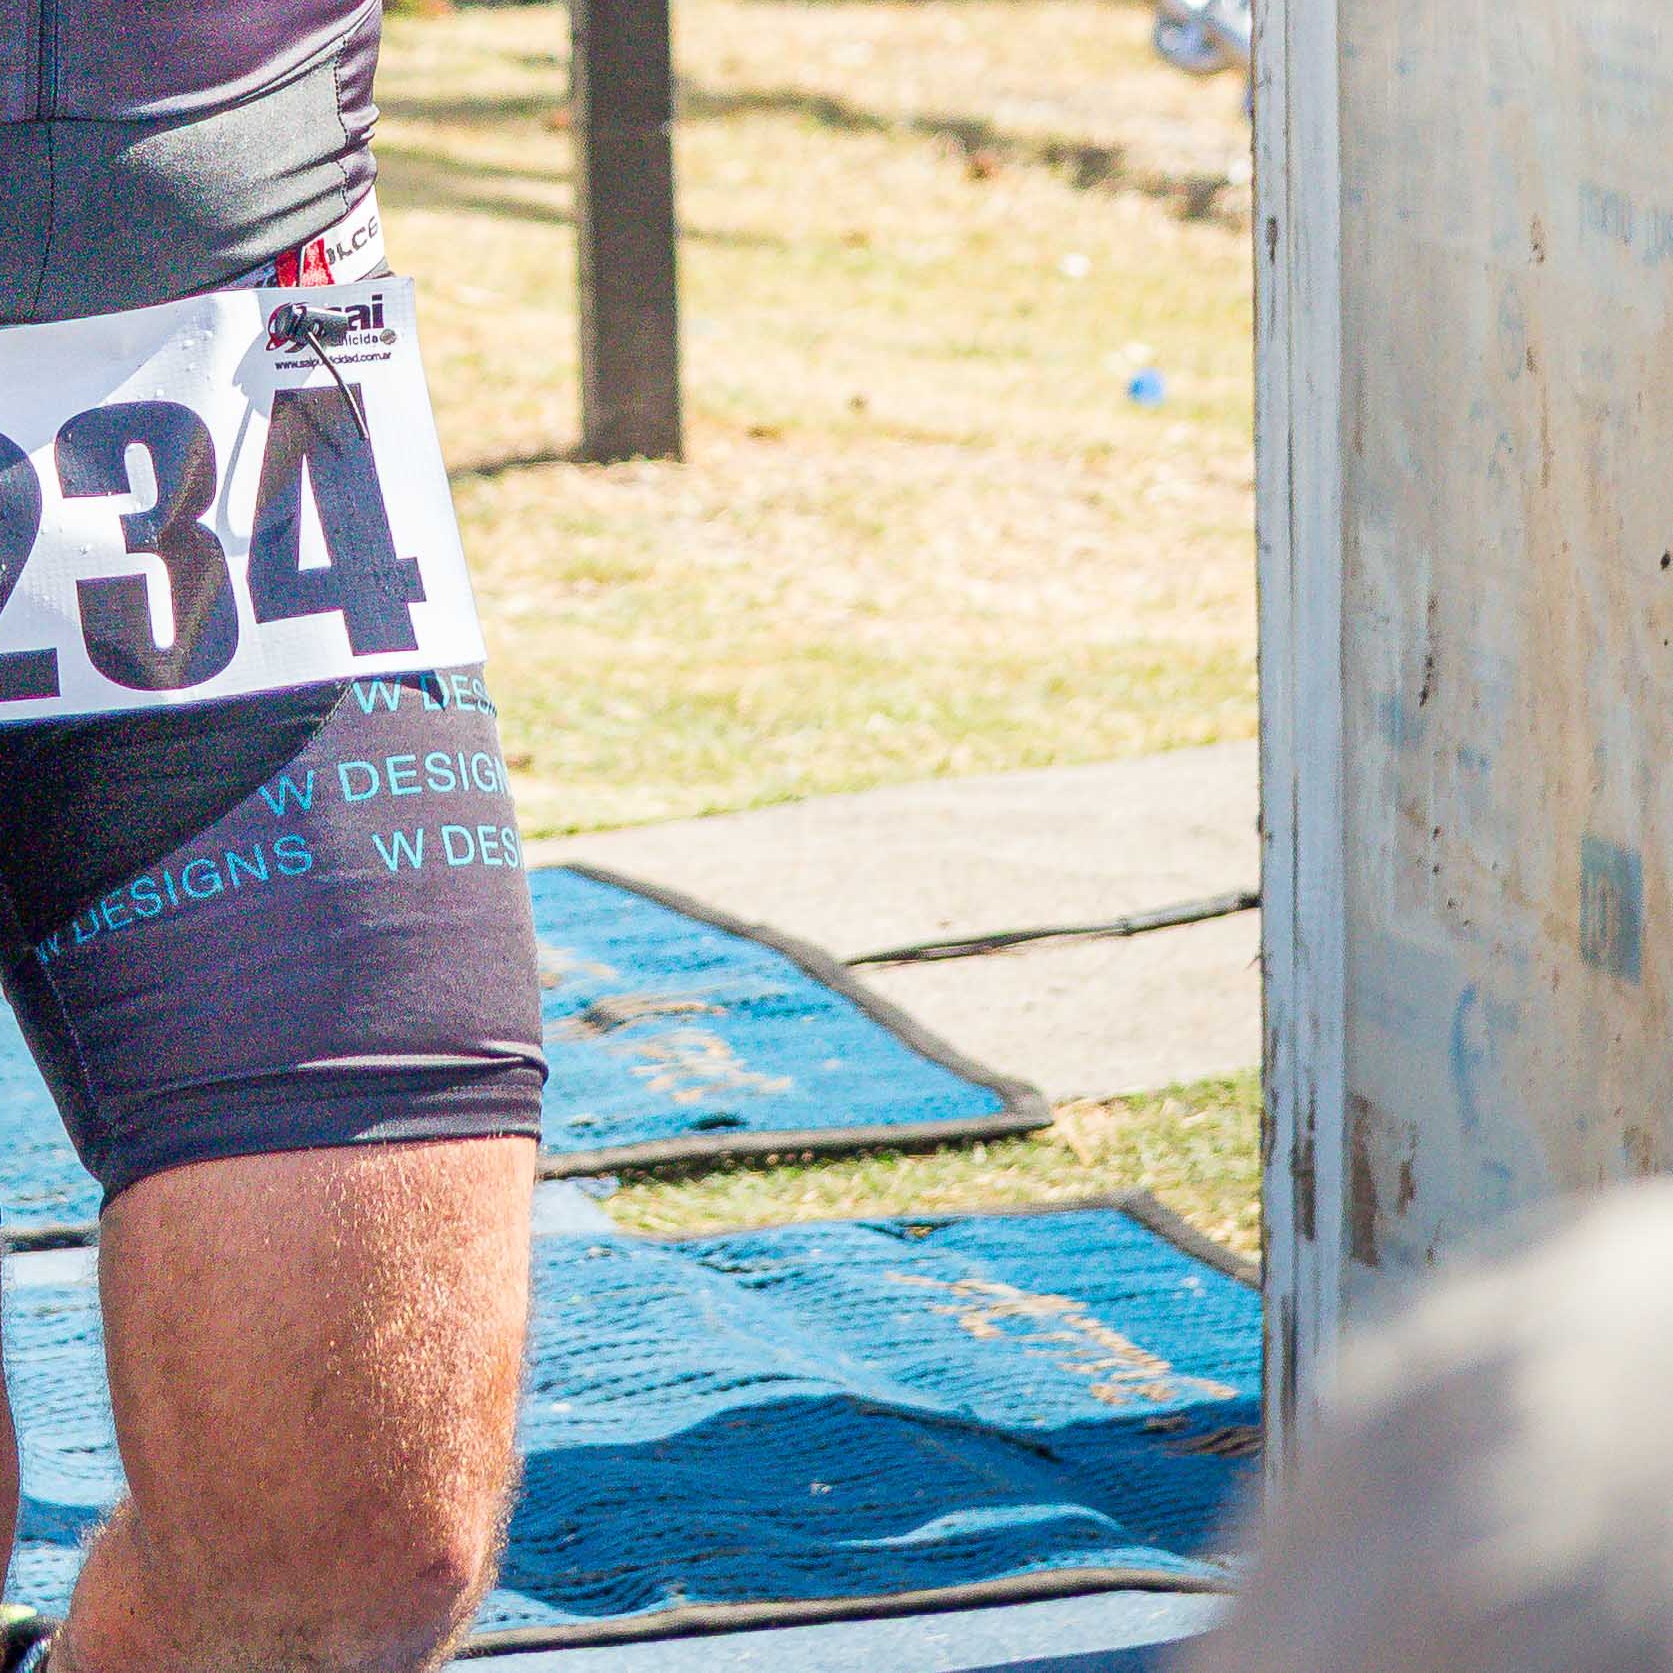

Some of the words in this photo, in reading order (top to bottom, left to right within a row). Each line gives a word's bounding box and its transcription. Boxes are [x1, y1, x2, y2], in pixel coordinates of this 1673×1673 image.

[353, 679, 402, 714] W
[258, 770, 314, 816] W
[371, 828, 425, 872] W
[71, 833, 313, 944] DESIGNS
